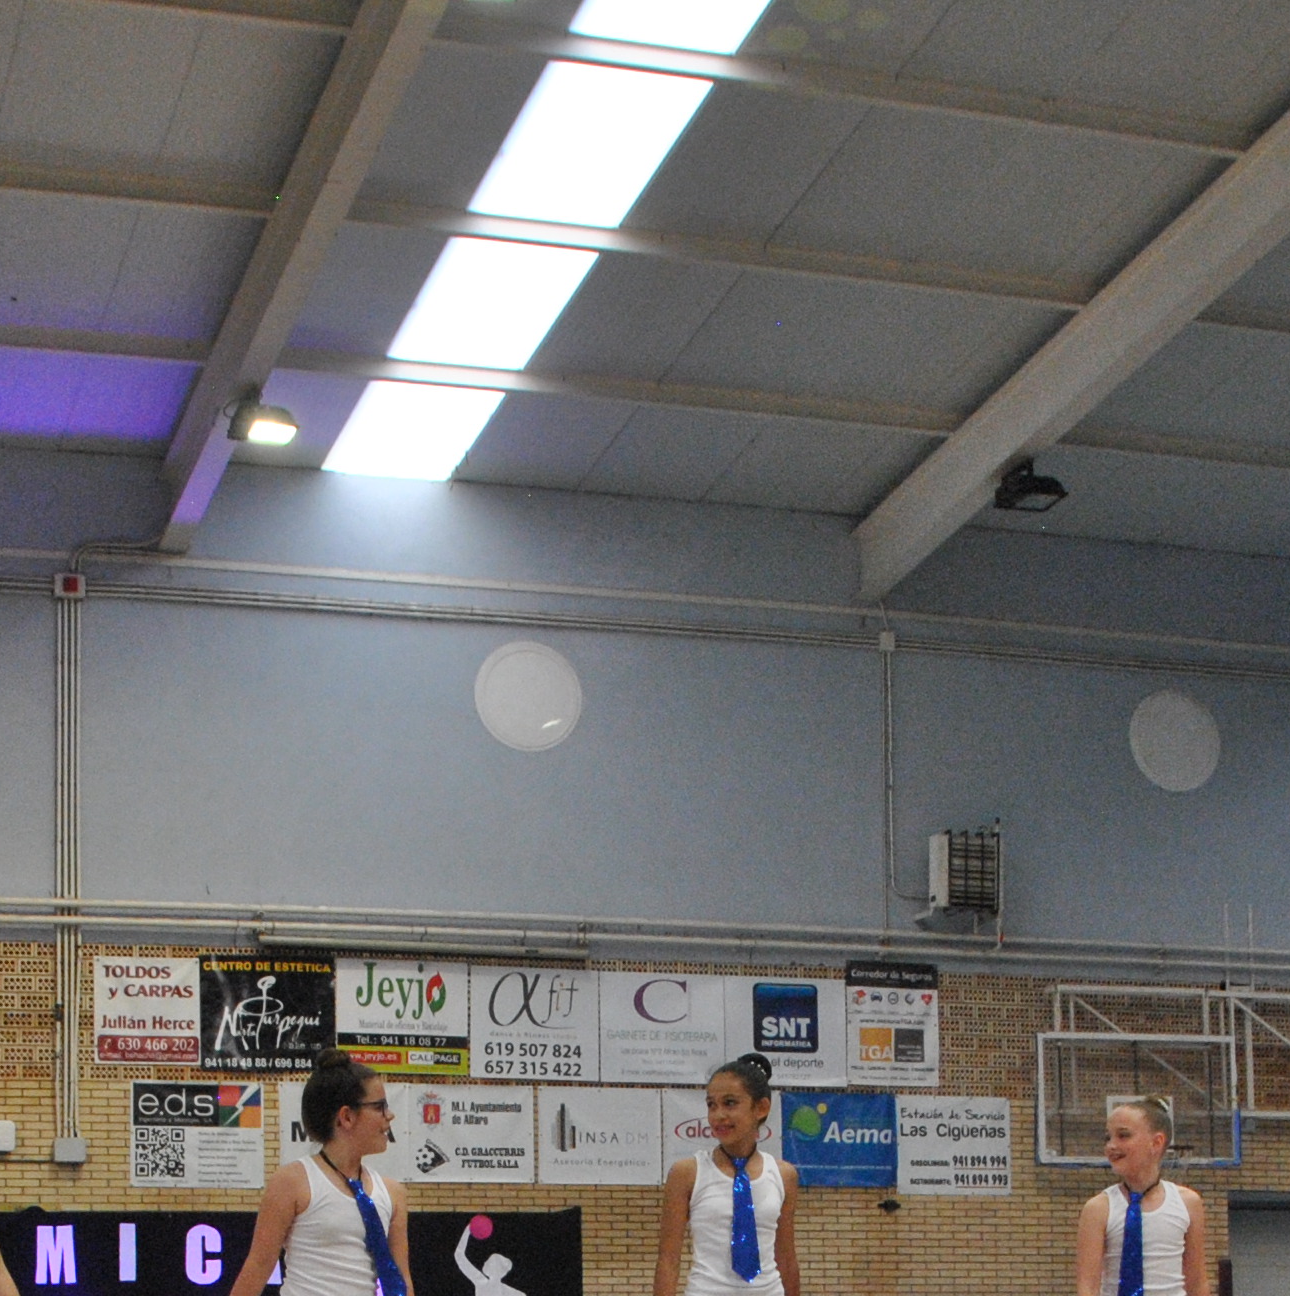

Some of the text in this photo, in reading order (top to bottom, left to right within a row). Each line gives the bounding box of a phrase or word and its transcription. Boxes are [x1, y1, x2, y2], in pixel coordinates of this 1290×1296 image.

[102, 965, 171, 979] TOLDOS
[203, 961, 252, 971] CENTRO
[255, 962, 271, 972] DE
[850, 968, 888, 979] Corredor
[890, 970, 900, 980] de
[107, 984, 194, 999] y CARPAS
[356, 961, 447, 1020] Jeyjo
[633, 979, 688, 1024] C
[101, 1014, 195, 1030] Julián Herce
[761, 1016, 811, 1038] SNT
[381, 1035, 399, 1045] 941
[404, 1036, 415, 1046] 18
[434, 1037, 447, 1046] 77
[649, 1031, 661, 1041] DE
[117, 1038, 194, 1051] 630 466 202
[485, 1042, 582, 1058] 619 507 824
[410, 1053, 460, 1063] CALIPAGE
[860, 1046, 893, 1060] TGA
[204, 1058, 222, 1068] 941
[485, 1060, 582, 1077] 657 315 422
[771, 1057, 825, 1069] el deporte
[469, 1101, 522, 1114] Ayuntamiento
[900, 1107, 1006, 1121] Estación de Servicio
[452, 1114, 489, 1125] de Alfaro
[579, 1132, 649, 1144] INSA DM
[823, 1121, 893, 1144] Aema
[900, 1123, 1006, 1141] Las Cigüeñas
[497, 1160, 520, 1169] SALA
[952, 1155, 968, 1167] 941
[970, 1155, 988, 1167] 894
[989, 1155, 1008, 1167] 994
[953, 1174, 970, 1186] 941
[972, 1174, 989, 1186] 894
[991, 1174, 1009, 1186] 993
